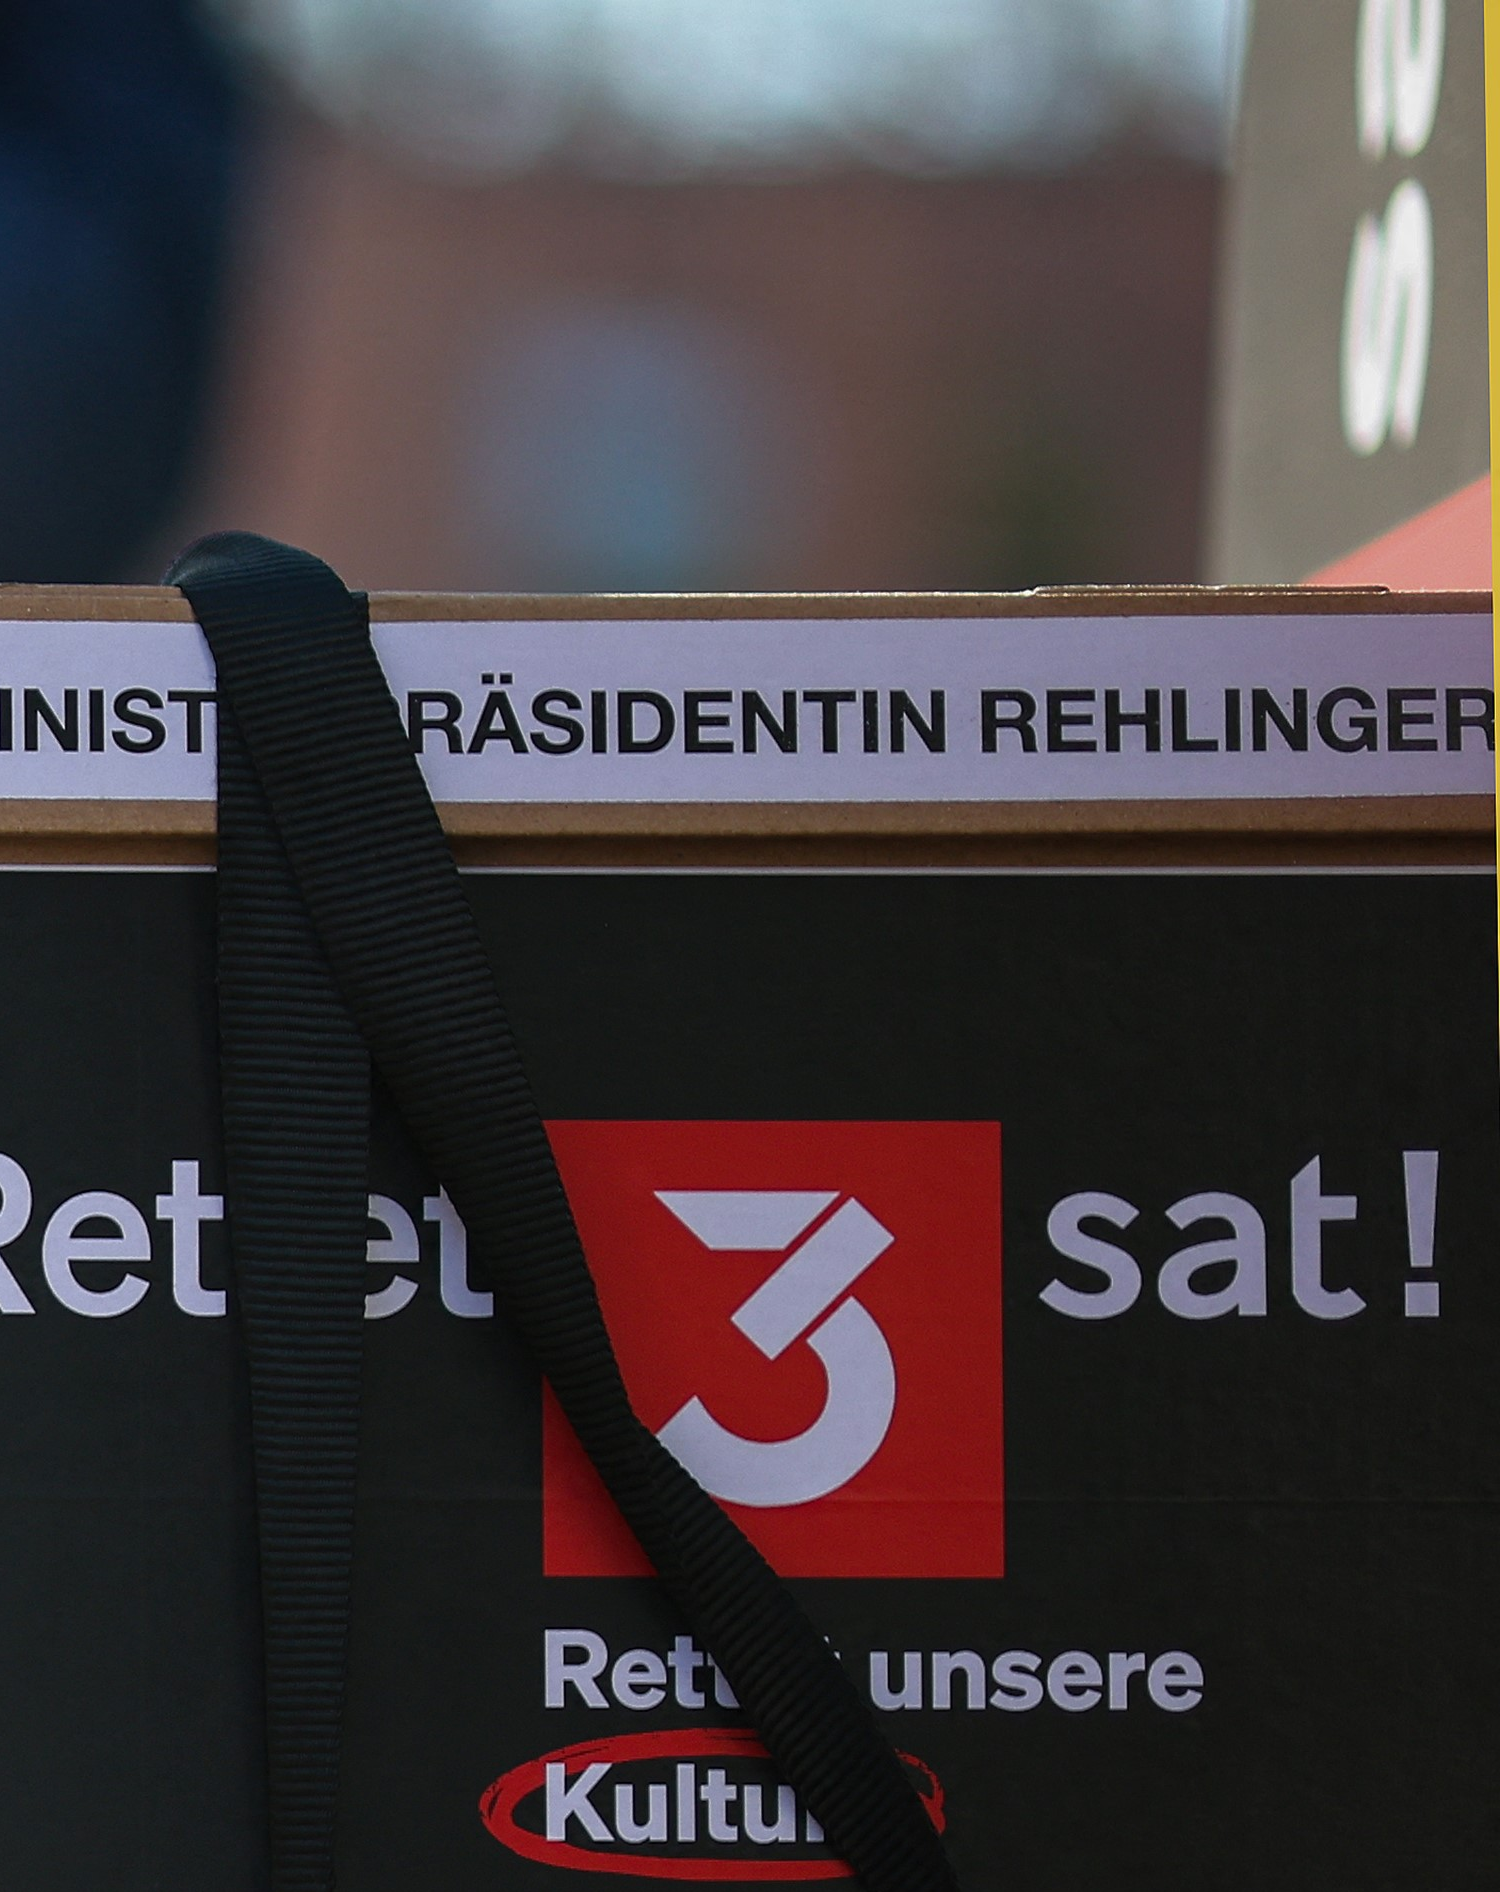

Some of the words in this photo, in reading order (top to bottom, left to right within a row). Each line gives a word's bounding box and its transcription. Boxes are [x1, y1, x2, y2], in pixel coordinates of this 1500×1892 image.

[979, 685, 1495, 755] REHLINGER
[652, 1189, 897, 1509] 3
[1037, 1149, 1441, 1321] sat!
[868, 1649, 1205, 1713] unsere
[544, 1761, 825, 1845] Kultu
